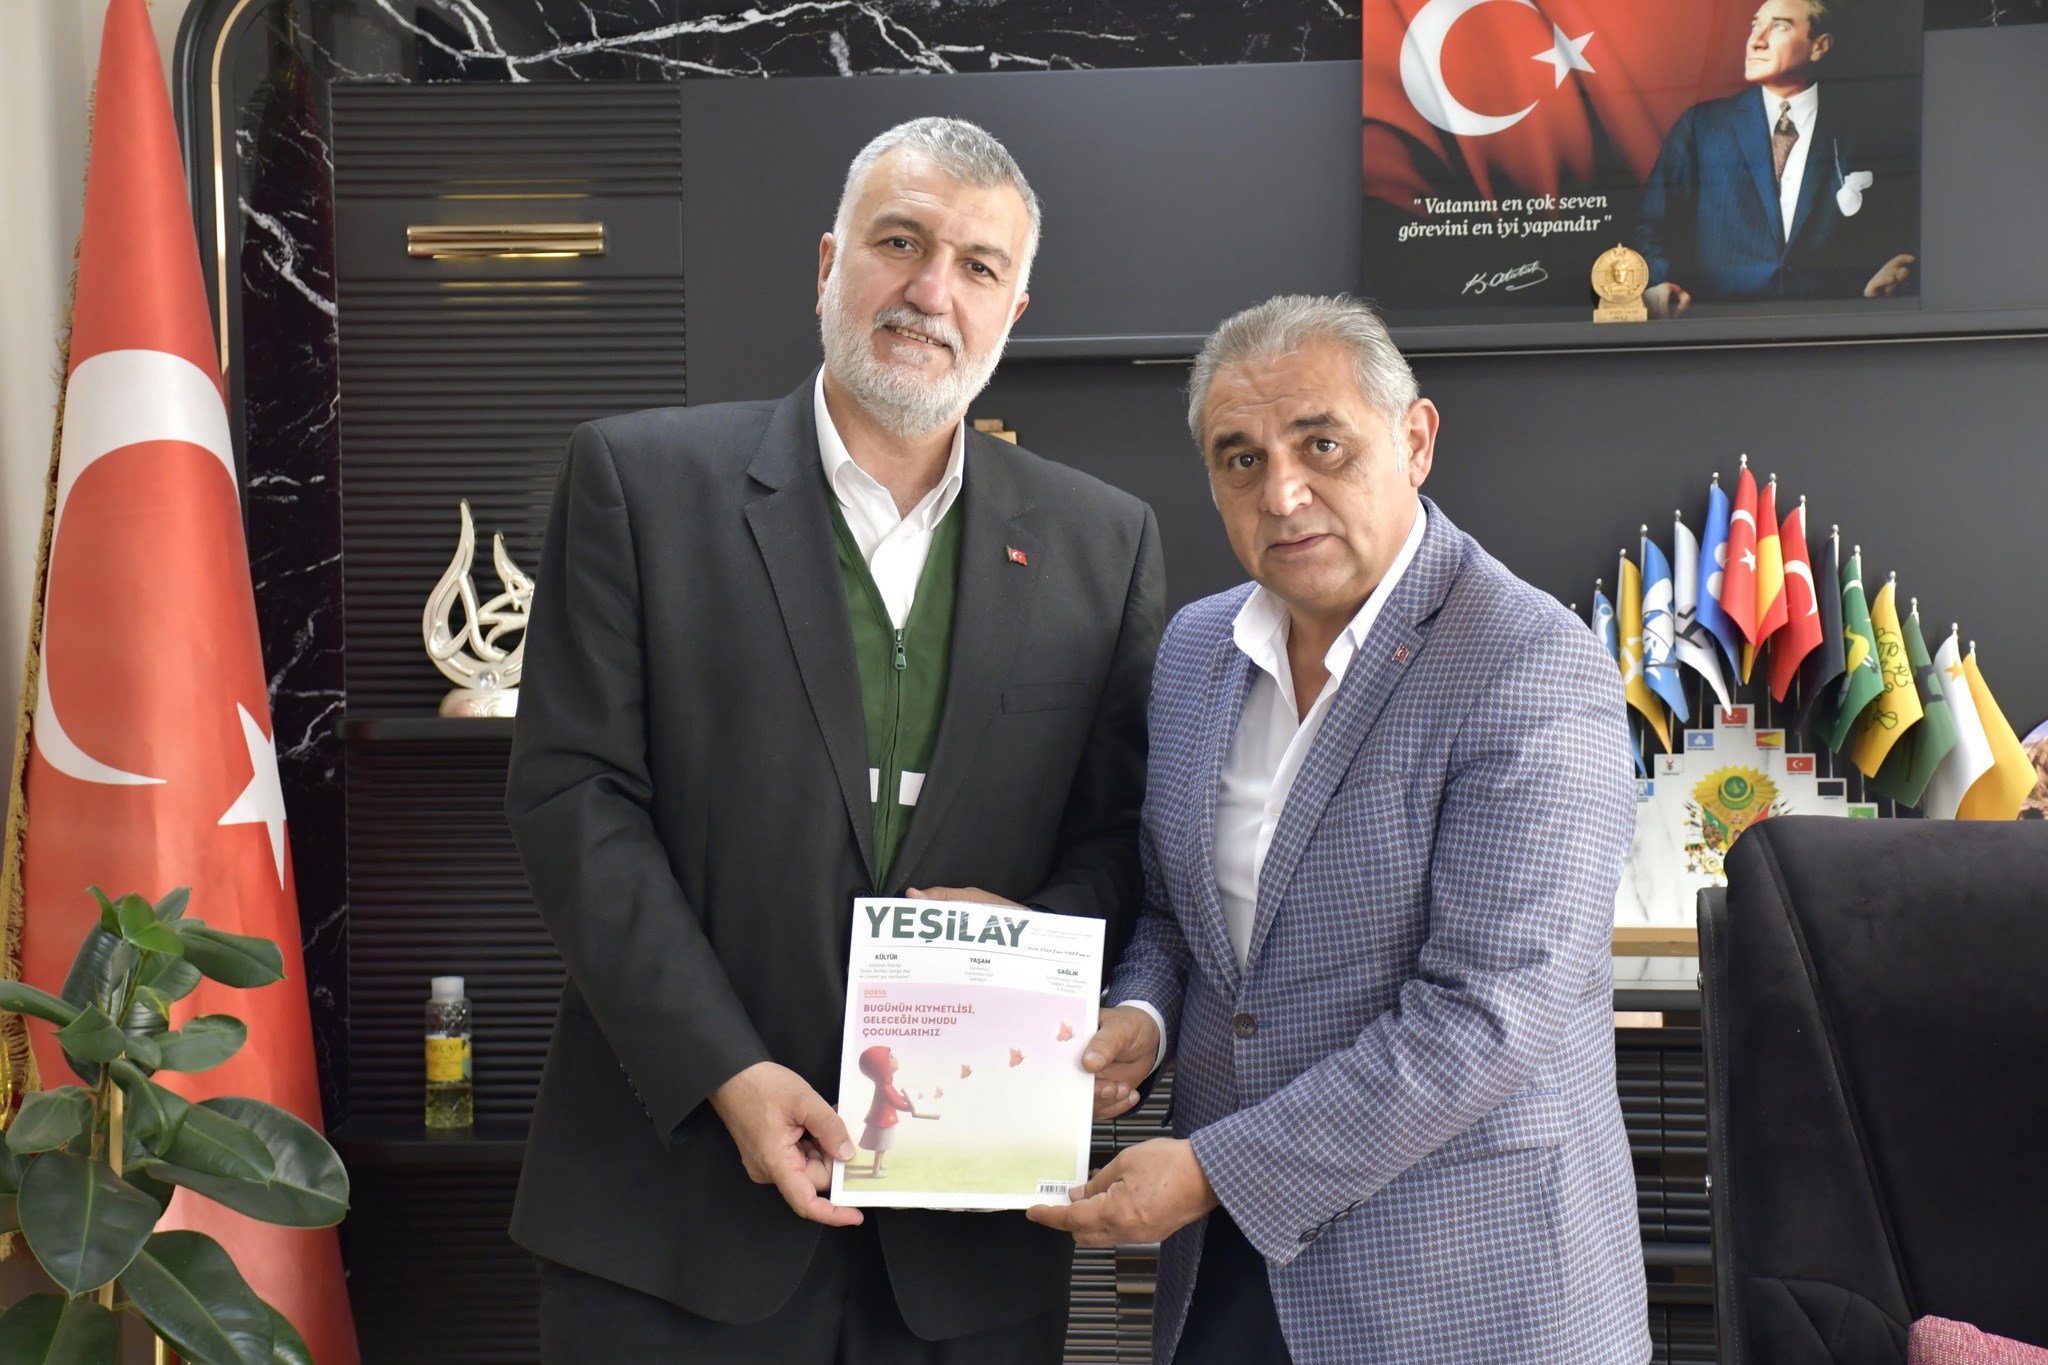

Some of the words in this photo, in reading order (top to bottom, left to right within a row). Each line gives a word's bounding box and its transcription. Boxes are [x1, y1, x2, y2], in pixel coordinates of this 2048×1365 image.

[1502, 199, 1523, 211] en
[1526, 194, 1555, 215] çok
[1559, 195, 1608, 209] seven
[1398, 219, 1469, 242] görevini
[1472, 222, 1494, 235] en
[1497, 217, 1520, 238] iyi
[970, 957, 991, 965] YAŞAM
[1057, 968, 1079, 977] SAĞLIK
[864, 1002, 913, 1012] BUGÜNÜN
[915, 1004, 975, 1015] KIYMETLİSİ,
[863, 1014, 919, 1025] GELECEĞİN
[921, 1017, 957, 1025] UMUDU
[862, 1027, 940, 1038] ÇOCUKLARIMIZ
